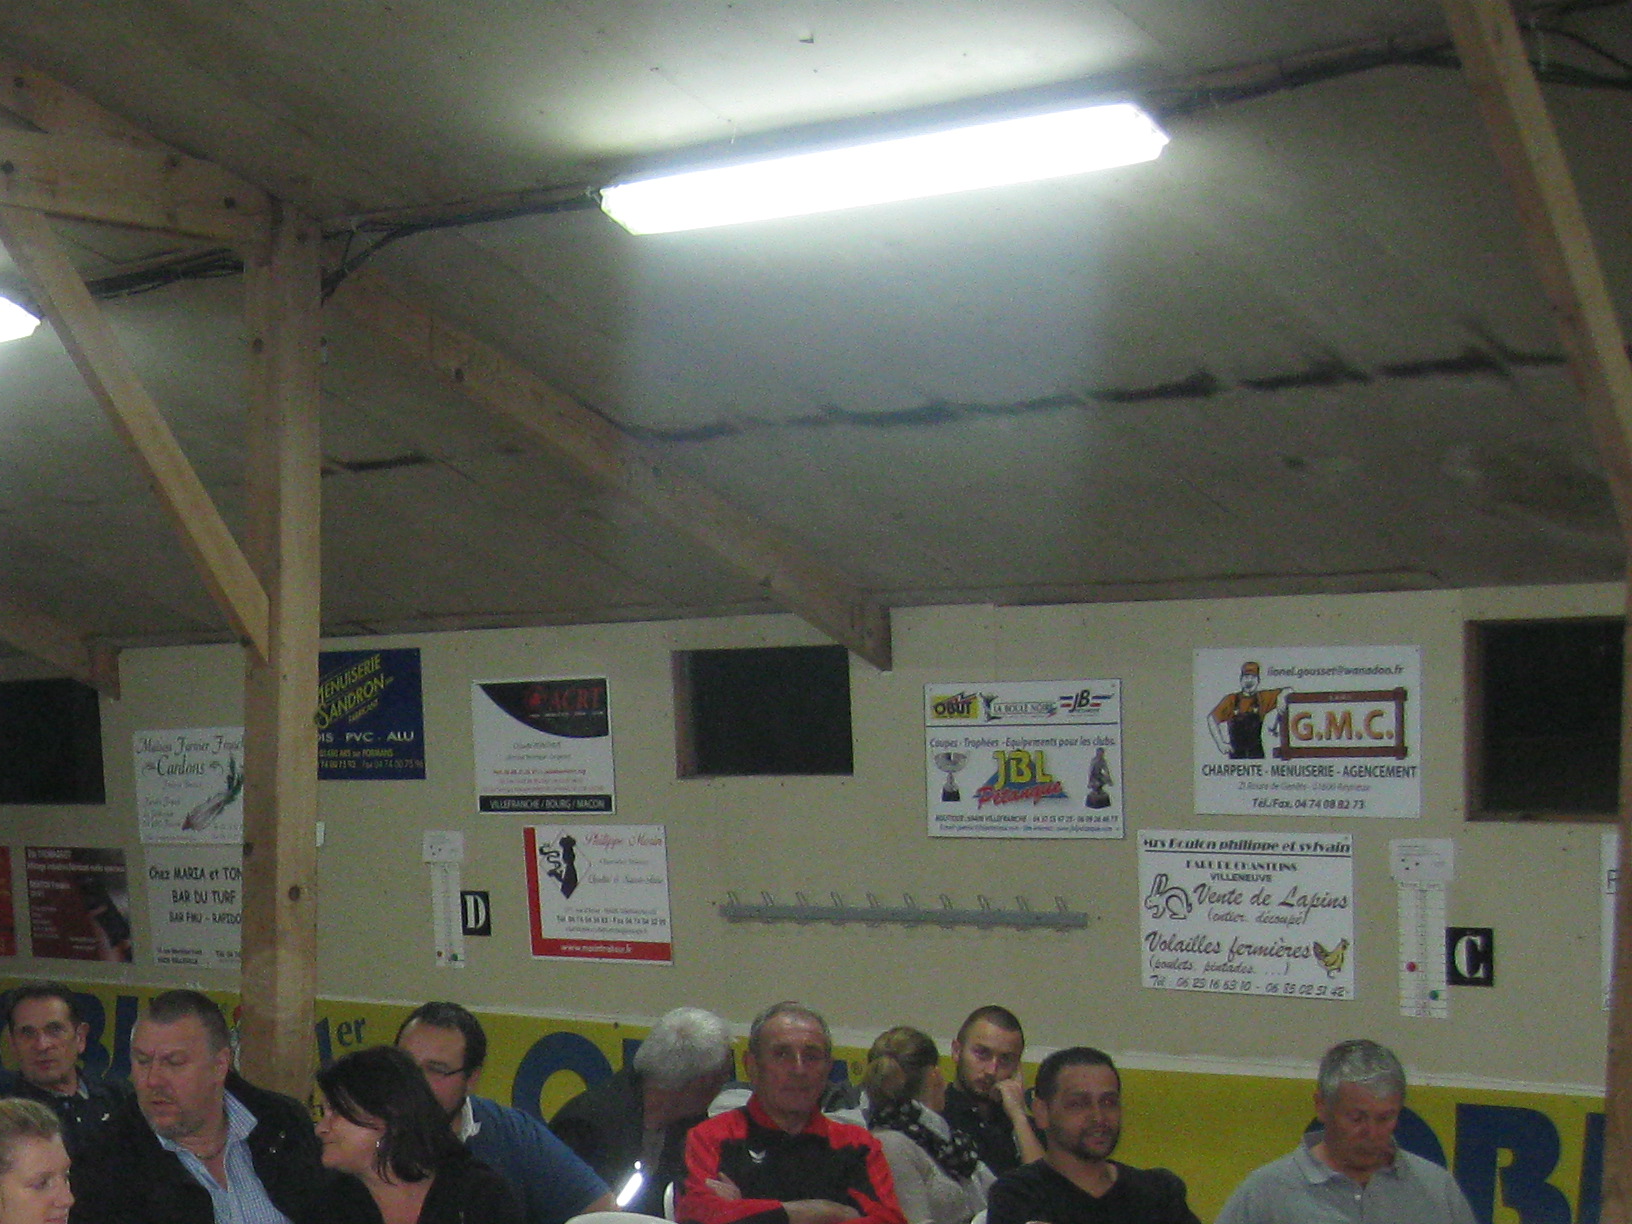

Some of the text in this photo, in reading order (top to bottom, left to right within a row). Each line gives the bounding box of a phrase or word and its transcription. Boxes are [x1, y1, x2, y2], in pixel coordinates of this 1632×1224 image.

[317, 673, 384, 729] SANDRON
[933, 700, 973, 715] OBUT
[1290, 709, 1394, 741] G.M.C.
[345, 732, 374, 743] PVC
[386, 731, 414, 742] ALU
[1058, 739, 1079, 748] pour
[1080, 737, 1091, 745] les
[993, 749, 1053, 791] JBL
[1201, 764, 1262, 777] CHARPENTE
[1270, 764, 1334, 777] MENUISERIE
[1342, 765, 1417, 778] AGENCEMENT
[489, 799, 540, 810] VILLEFRANCHE
[1309, 800, 1322, 810] 74
[1218, 838, 1279, 852] philippe
[1281, 840, 1296, 851] et
[1298, 841, 1351, 854] sylvain
[148, 866, 170, 880] Chez
[173, 866, 206, 880] MARIA
[209, 869, 219, 881] et
[1210, 873, 1272, 883] VILLENEUVE
[171, 889, 236, 905] BAR DU TURF
[1193, 883, 1349, 913] Vente de Lapins
[169, 911, 184, 923] BAR
[211, 912, 242, 925] RAPIDO
[1144, 930, 1312, 963] Volailles fermières
[1454, 935, 1484, 979] C
[314, 1017, 366, 1069] 1er
